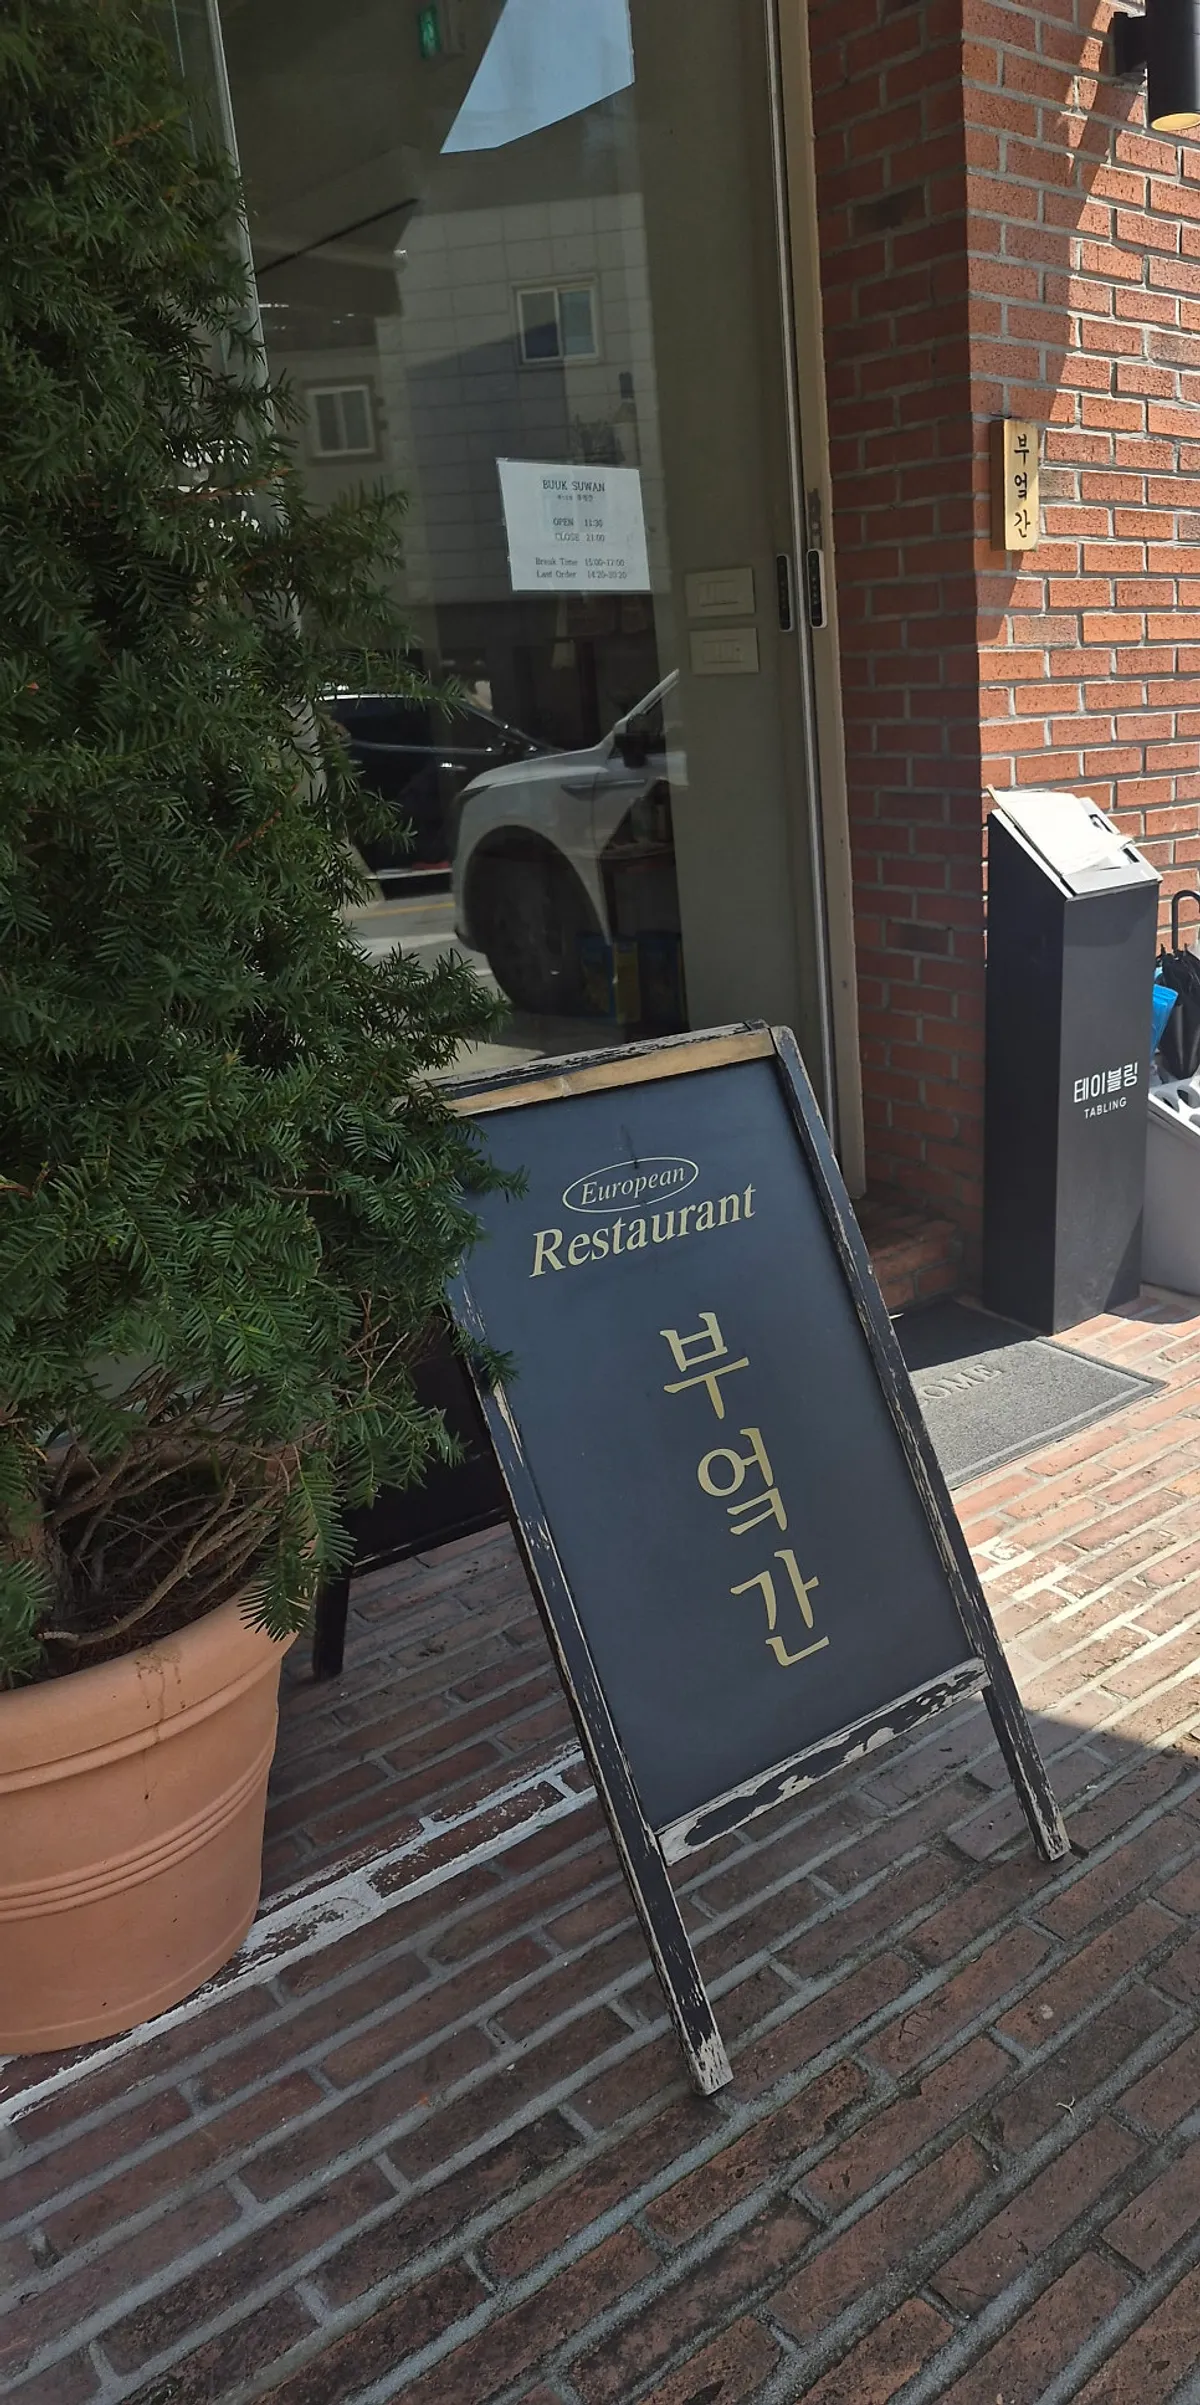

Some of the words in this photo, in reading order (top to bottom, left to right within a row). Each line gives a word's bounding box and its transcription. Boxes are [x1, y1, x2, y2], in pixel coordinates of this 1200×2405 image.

[1013, 433, 1031, 538] 부엌간
[552, 517, 574, 527] OPEN
[555, 532, 580, 542] CLOSE
[535, 556, 557, 566] Break
[559, 557, 578, 567] Time
[536, 569, 553, 579] Last
[555, 569, 577, 579] Order
[1074, 1062, 1138, 1103] 테이블링
[1084, 1096, 1127, 1119] TABLING
[581, 1165, 686, 1206] European
[529, 1183, 757, 1279] Restaurant
[917, 1363, 1004, 1408] OME
[660, 1312, 830, 1667] 부엌간
